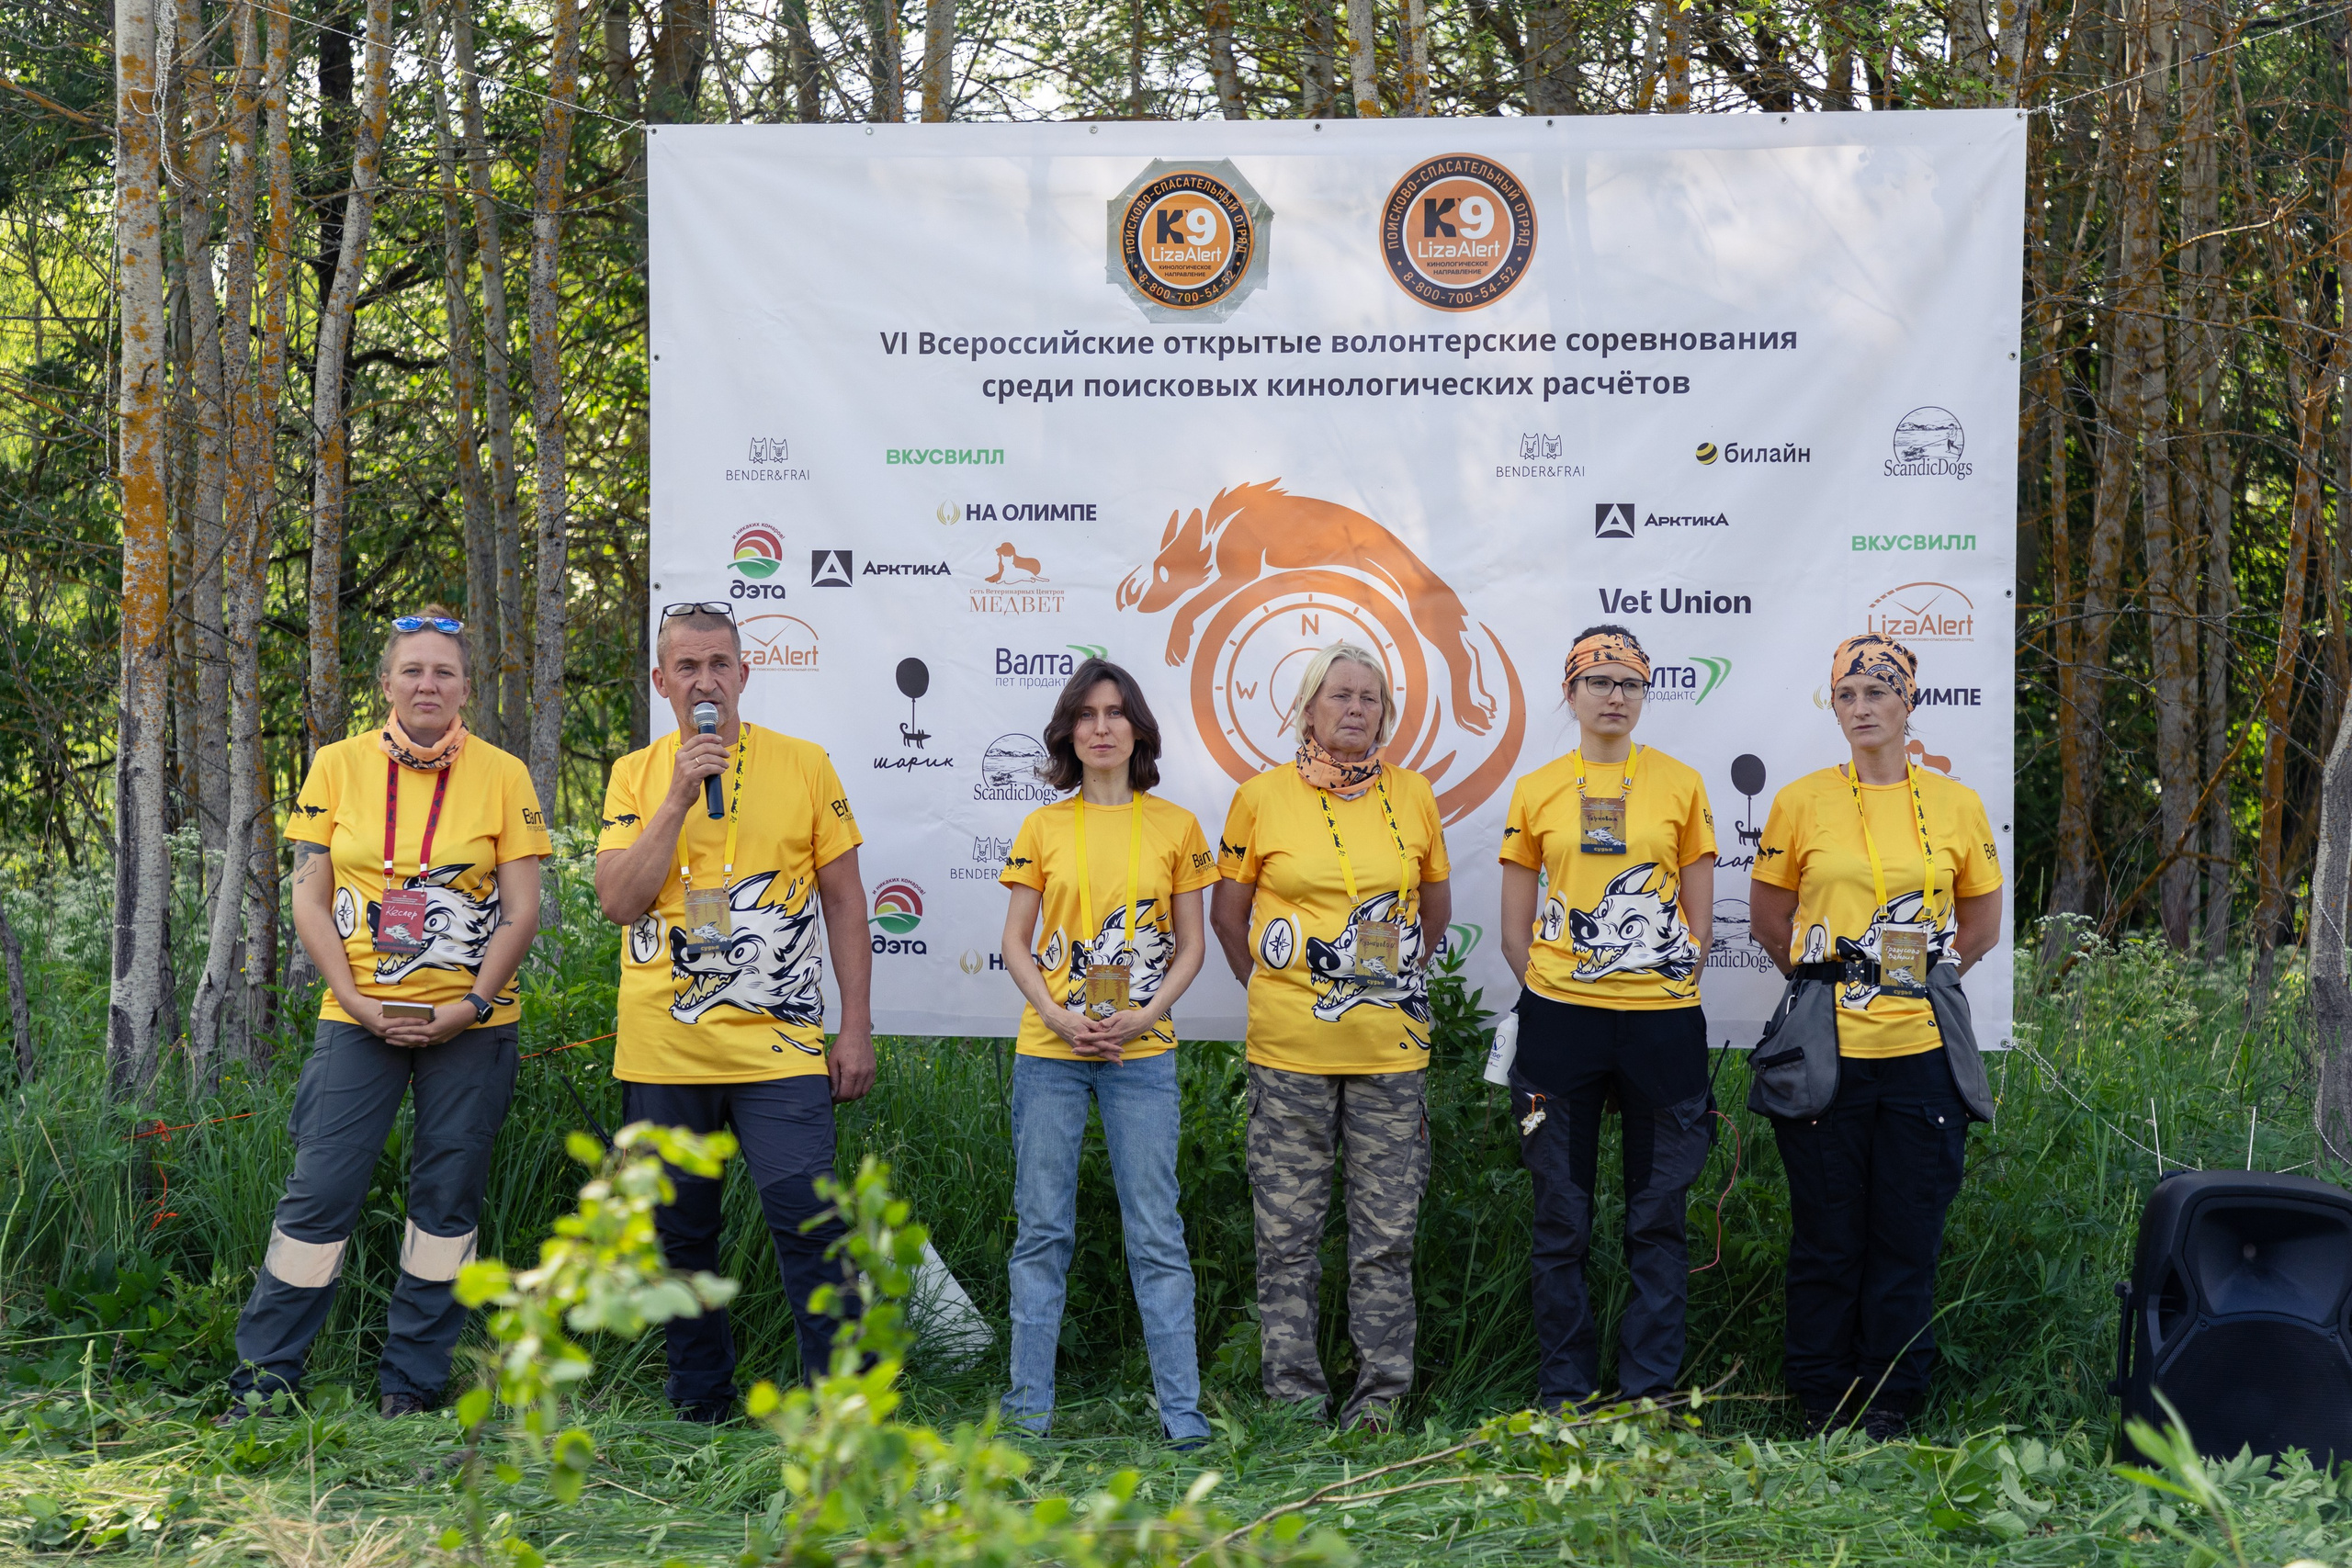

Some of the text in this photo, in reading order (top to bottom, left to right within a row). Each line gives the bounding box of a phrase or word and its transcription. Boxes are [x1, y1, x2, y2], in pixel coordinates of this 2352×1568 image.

[1125, 176, 1248, 254] ПОИСКОВО-СПАСАТЕЛЬНЫЙ ОТРЯД
[1386, 160, 1530, 250] ПОИСКОВО-СПАСАТЕЛЬНЫЙ ОТРЯД
[1156, 208, 1217, 246] K9
[1424, 196, 1495, 240] K9
[1151, 247, 1222, 262] LizaAlert
[1418, 240, 1500, 258] LizaAlert
[1138, 269, 1238, 303] 8-800-700-54-52
[1403, 265, 1518, 305] 8-800-700-54-52
[879, 329, 1797, 362] VI Всероссийские открытые волонтерские соревнования
[982, 370, 1690, 405] среди поисковых кинологических расчётов
[886, 448, 1004, 465] ВКУСВИЛЛ
[1724, 442, 1811, 464] билайн
[726, 468, 810, 481] BENDER&FRAI
[1496, 465, 1586, 478] BENDER&FRAI
[1883, 457, 1973, 480] ScandicDogs
[966, 502, 1097, 522] НА ОЛИМПЕ
[735, 522, 761, 536] никаких
[761, 522, 786, 540] комаров!
[1851, 535, 1976, 551] ВКУСВИЛЛ
[969, 596, 1065, 616] МЕДВЕТ
[1599, 588, 1753, 615] Vet Union
[1301, 614, 1319, 637] N
[1868, 614, 1974, 636] LizaAlert
[741, 645, 820, 666] zaAlert
[995, 648, 1073, 675] Валта
[995, 677, 1068, 690] пет продакт
[1650, 666, 1696, 689] лта
[1236, 681, 1259, 700] W
[1648, 690, 1696, 703] родактс
[1917, 687, 1982, 706] ИМПЕ
[873, 755, 954, 773] шарик
[973, 783, 1058, 807] ScandicDogs
[876, 877, 899, 891] никаких
[900, 877, 926, 896] комаров!
[1703, 949, 1775, 974] andicDogs
